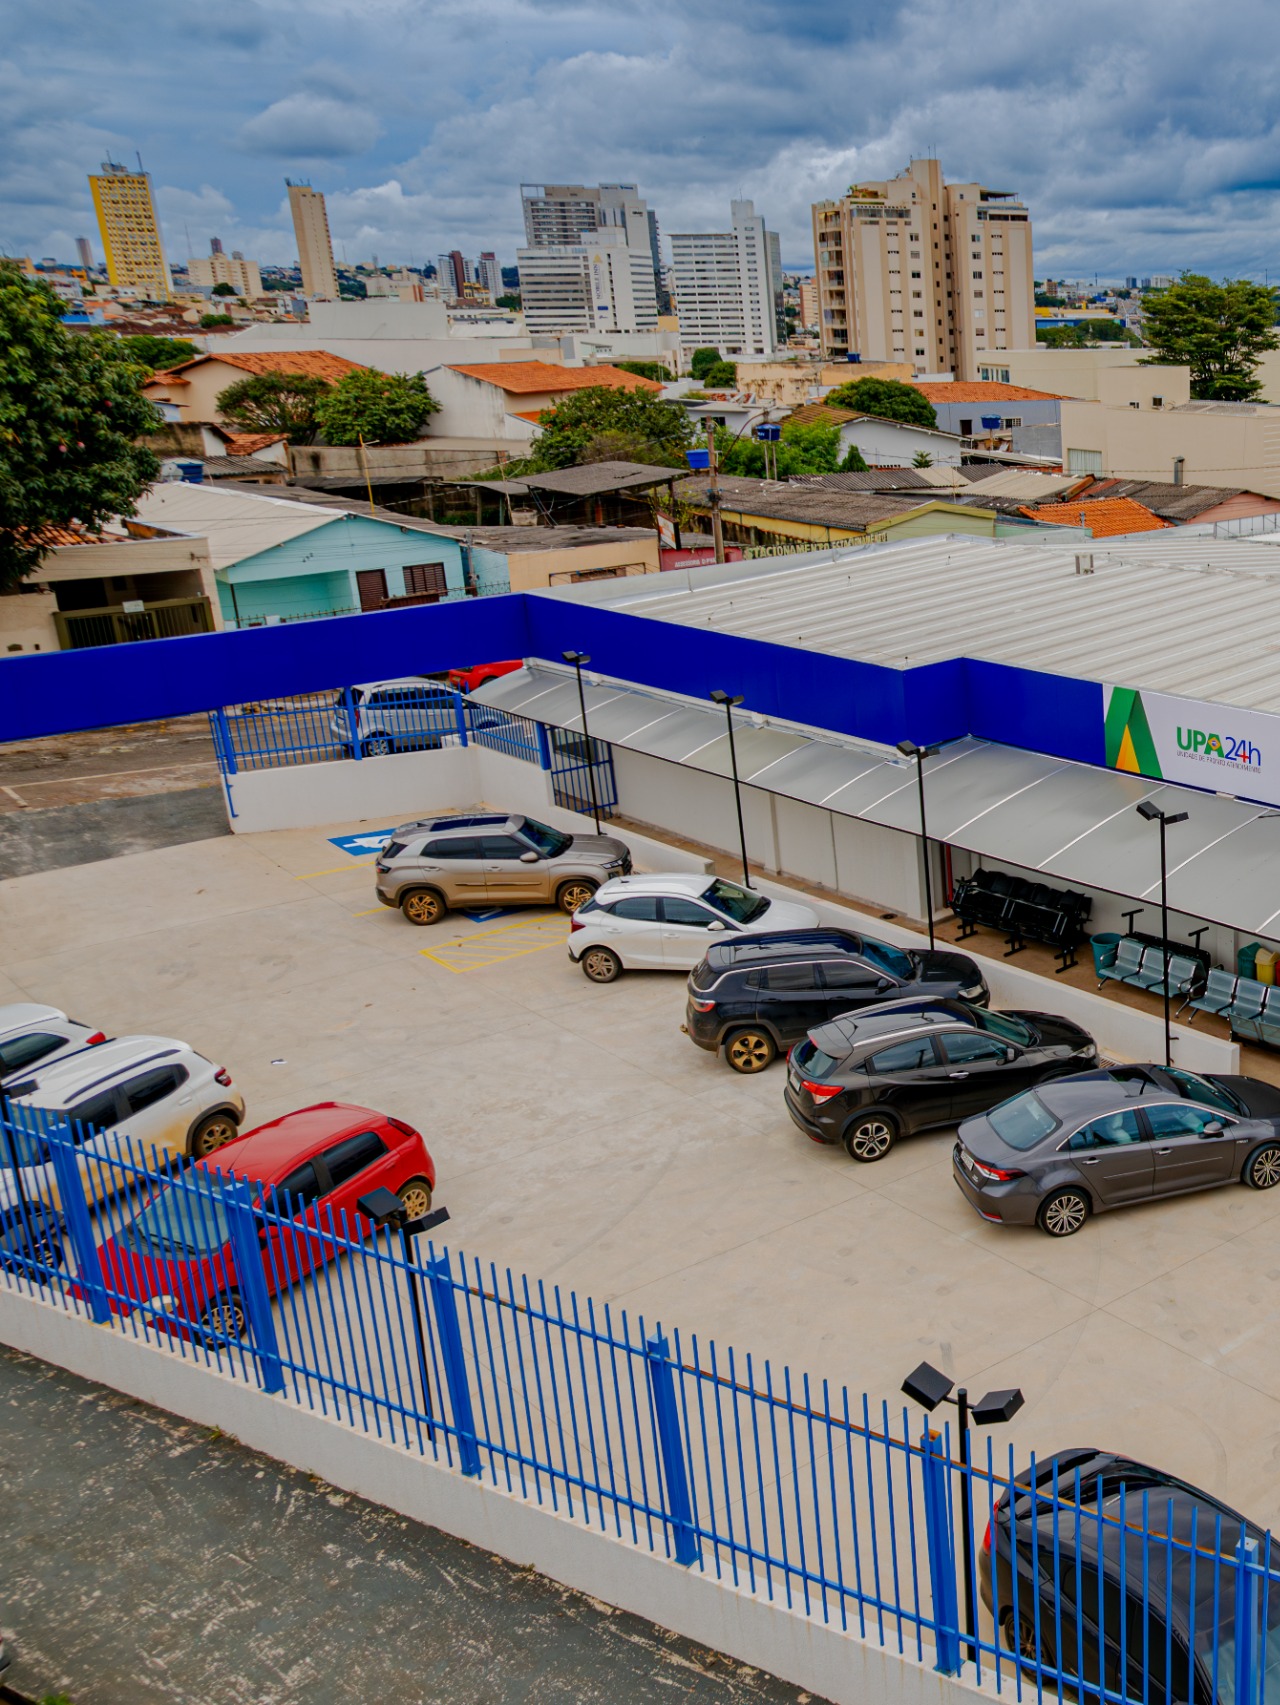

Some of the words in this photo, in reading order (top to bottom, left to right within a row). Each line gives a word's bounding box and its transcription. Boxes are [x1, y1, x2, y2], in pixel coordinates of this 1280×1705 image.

[1176, 726, 1225, 758] UPA
[1225, 736, 1261, 766] 24h
[1176, 750, 1198, 761] UNIDADE
[1198, 754, 1205, 762] DE
[1206, 756, 1226, 767] PRONTO
[1226, 761, 1262, 774] ATENDIMENTO
